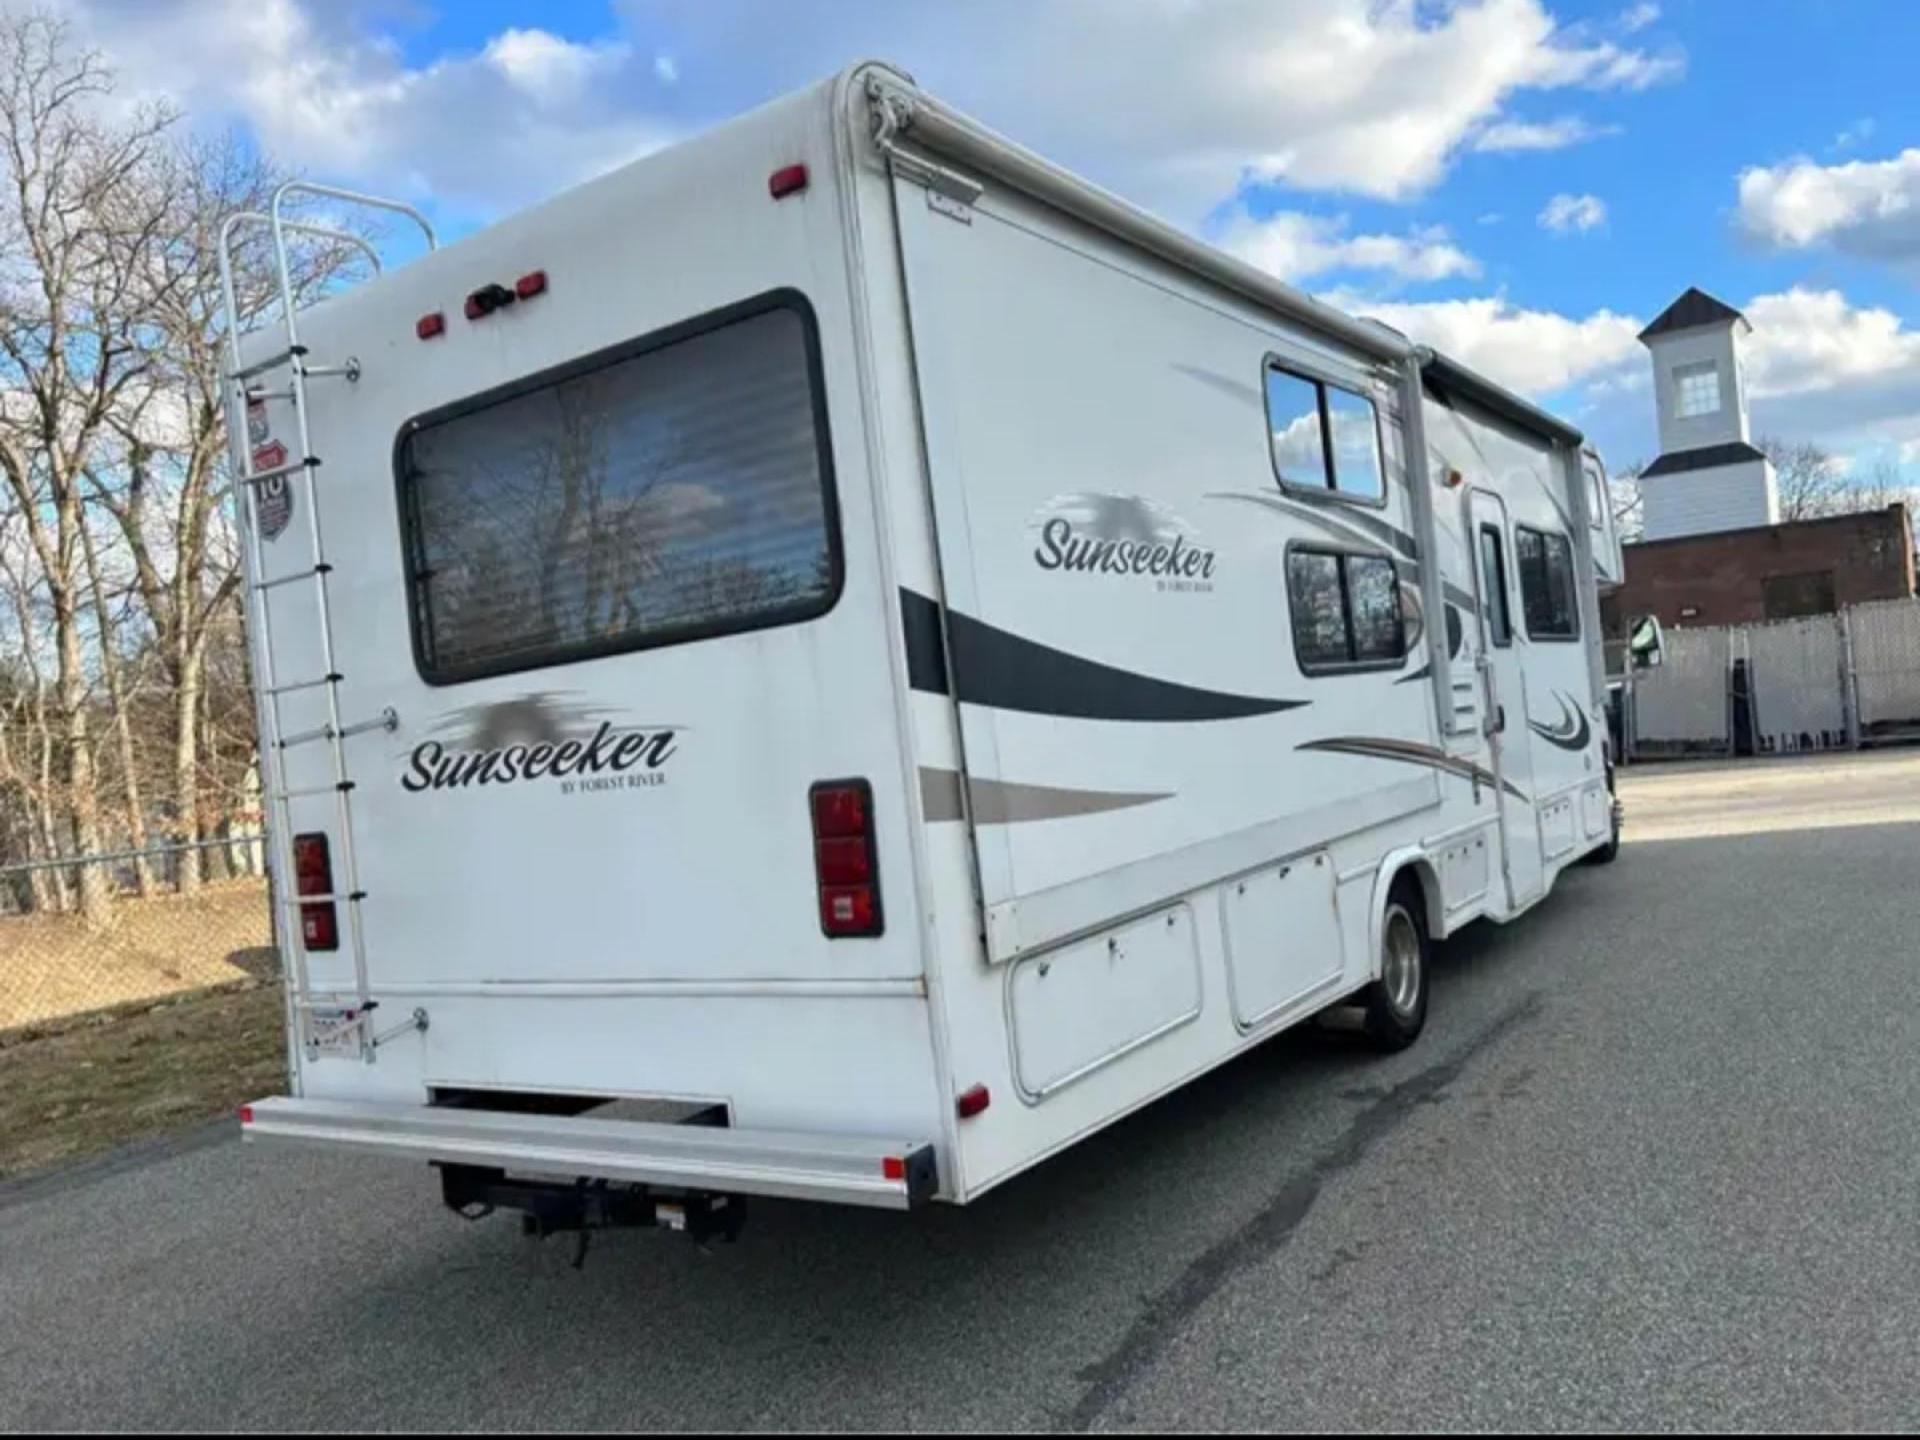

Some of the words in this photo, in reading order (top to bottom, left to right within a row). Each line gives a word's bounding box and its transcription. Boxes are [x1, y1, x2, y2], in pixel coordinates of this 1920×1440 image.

[1035, 517, 1215, 579] Sunseeker
[401, 720, 677, 792] Sunseeker
[561, 780, 576, 795] BY
[580, 775, 625, 793] FOREST
[627, 771, 666, 788] RIVER
